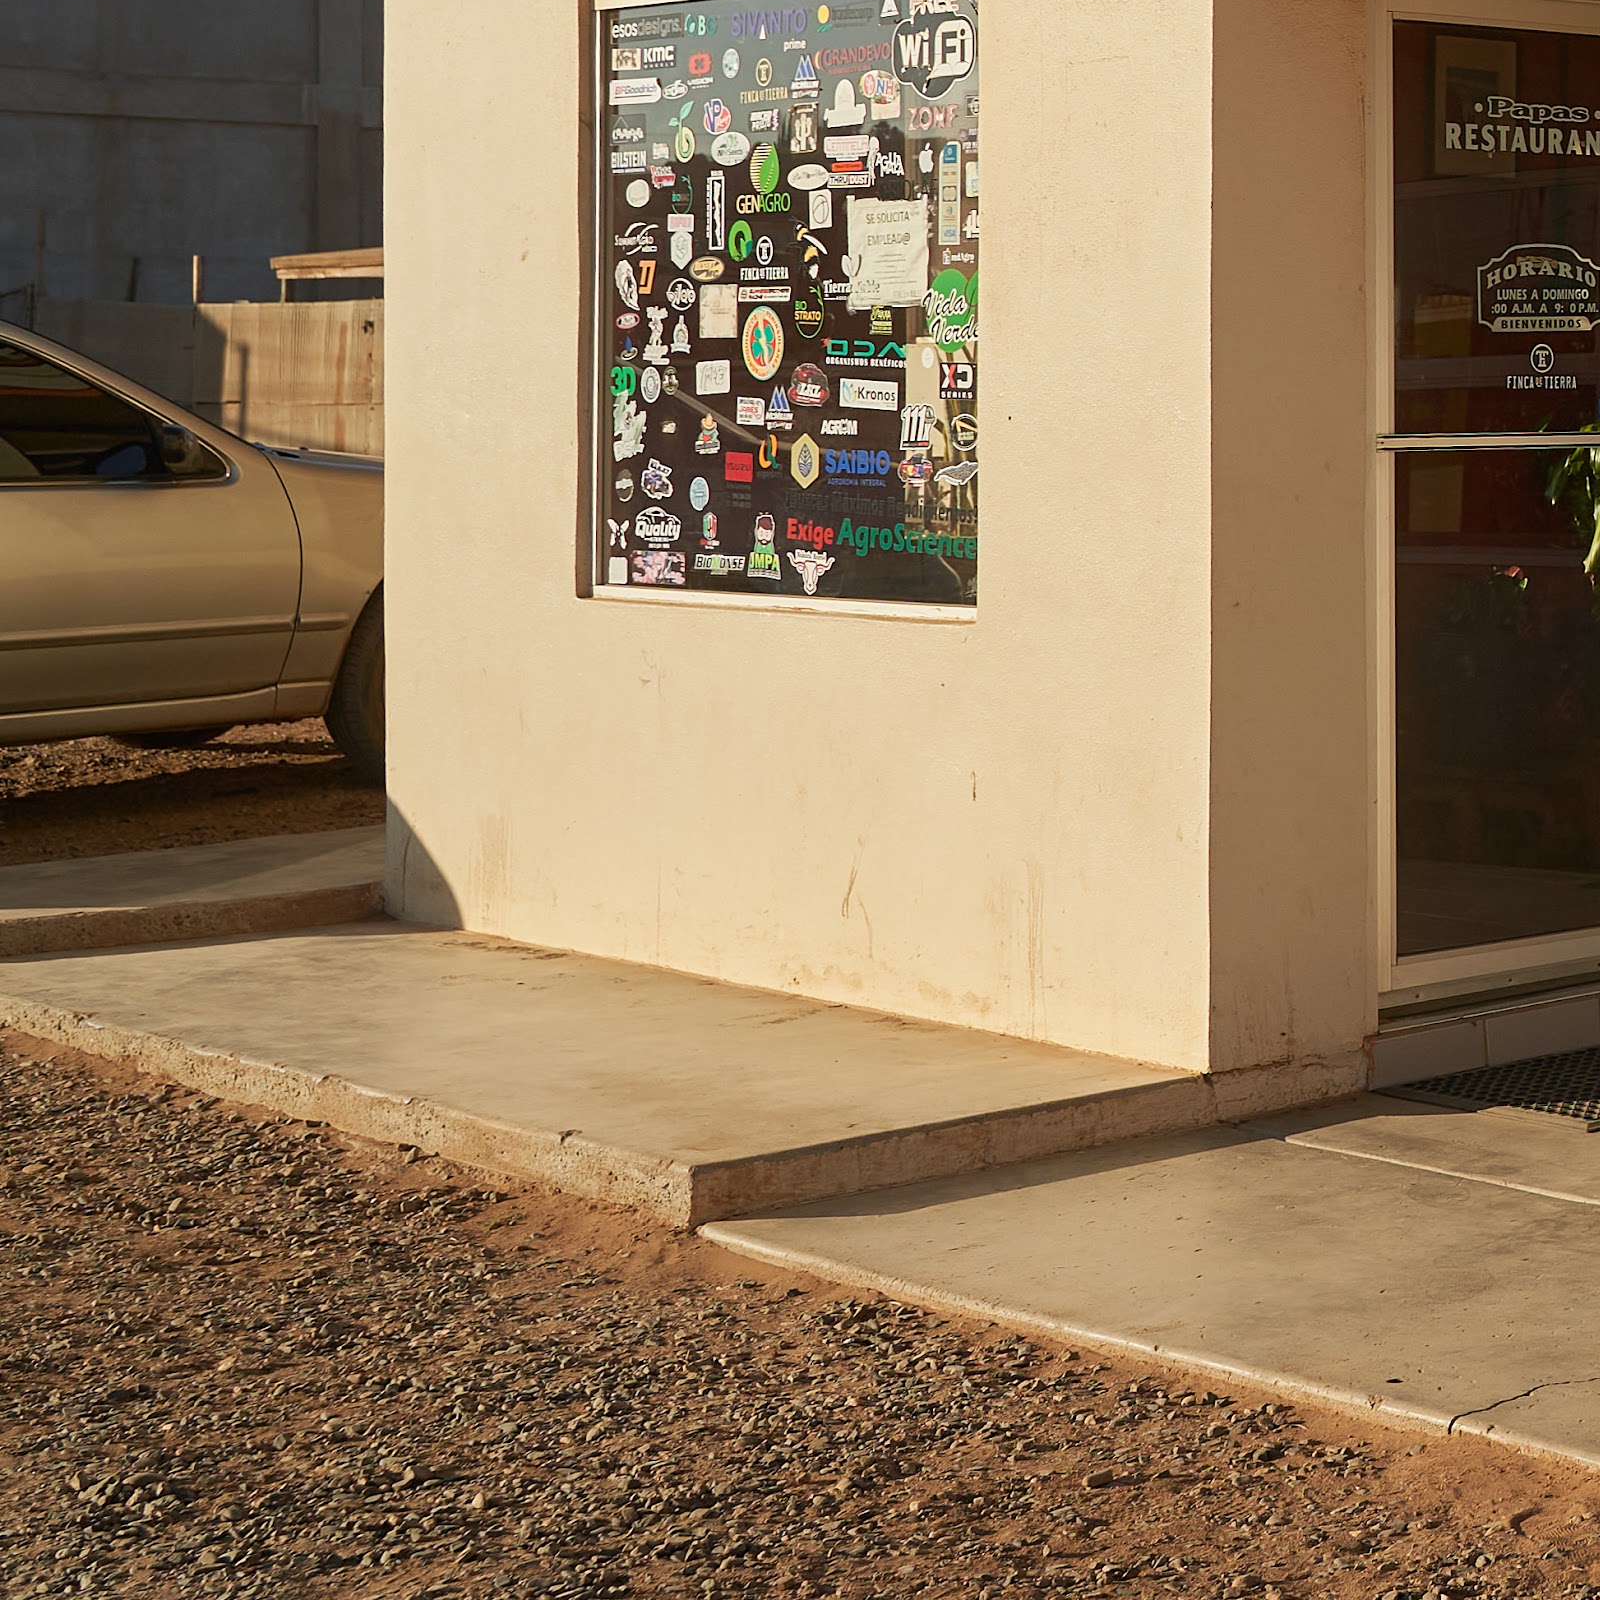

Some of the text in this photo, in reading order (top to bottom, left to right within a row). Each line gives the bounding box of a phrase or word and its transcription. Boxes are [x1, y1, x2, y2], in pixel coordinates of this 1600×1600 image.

[731, 8, 808, 37] SIVANTO
[783, 38, 807, 52] prime
[822, 43, 892, 67] GRANDEVO
[1487, 96, 1590, 124] Papas
[611, 151, 647, 168] BILSTEIN
[849, 174, 868, 185] DUST
[736, 192, 791, 214] GENAGRO
[866, 211, 910, 225] SE SOLICITA
[1486, 260, 1596, 289] HORARIO
[822, 278, 852, 294] Tierra
[1497, 288, 1589, 300] LUNES A DOMINGO
[921, 288, 966, 319] Vida
[1539, 303, 1548, 314] A
[794, 310, 821, 322] STRATO
[1501, 319, 1582, 329] BIENVENIDOS
[825, 356, 908, 369] ORGANISMOS BENÉFICOS
[610, 365, 637, 397] 3D
[1506, 375, 1535, 389] FINCA
[1544, 375, 1577, 389] TIERRA
[857, 386, 896, 402] Kronos
[940, 390, 974, 400] SERIES
[727, 462, 751, 471] ISUZU
[824, 448, 891, 475] SAIBIO
[635, 519, 682, 541] Quality
[786, 517, 977, 559] Exige AgroScience
